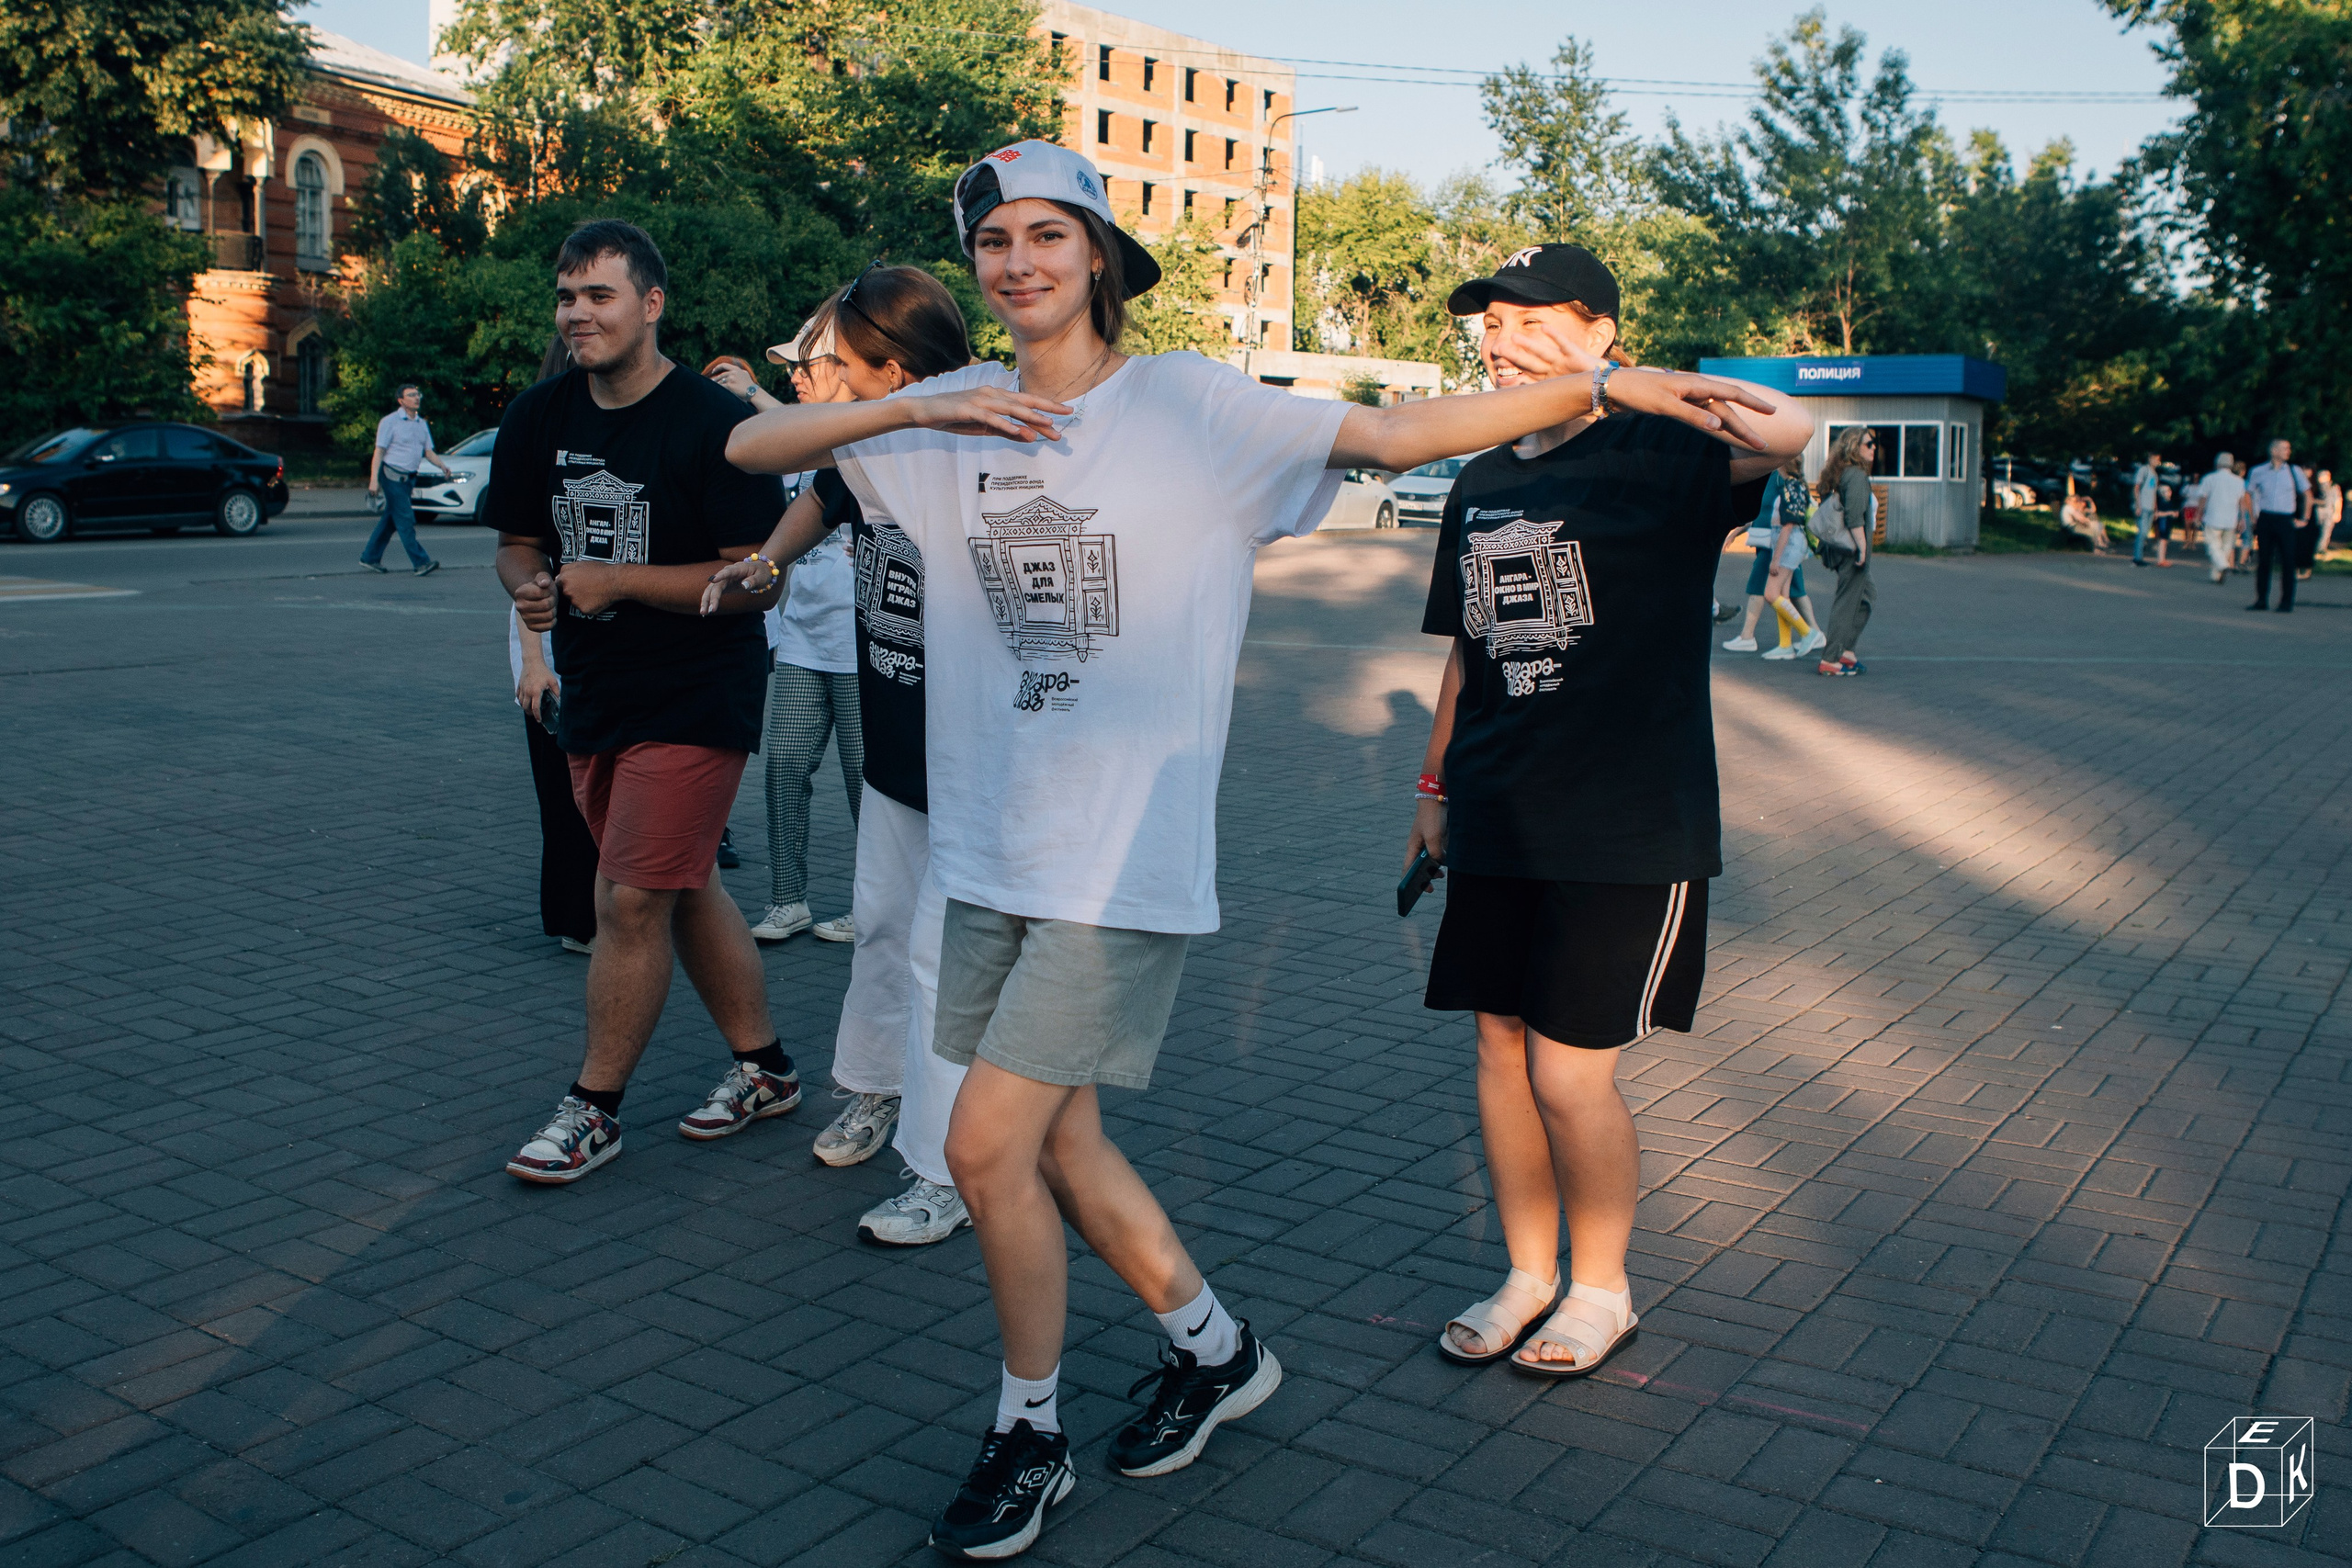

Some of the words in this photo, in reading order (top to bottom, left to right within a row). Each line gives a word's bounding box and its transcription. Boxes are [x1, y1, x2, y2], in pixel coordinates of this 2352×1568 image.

[1799, 367, 1861, 381] ПОЛИЦИЯ
[1023, 561, 1056, 574] ДЖАЗ
[888, 570, 917, 590] ВНУТРИ
[1032, 577, 1054, 589] ДЛЯ
[887, 581, 917, 598] ИГРАЕТ
[1494, 585, 1516, 594] ОКНО
[1516, 584, 1522, 592] В
[1522, 582, 1539, 592] МИР
[887, 593, 917, 608] ДЖАЗ
[1023, 592, 1065, 604] СМЕЛЫХ
[1502, 593, 1533, 605] ДЖАЗА
